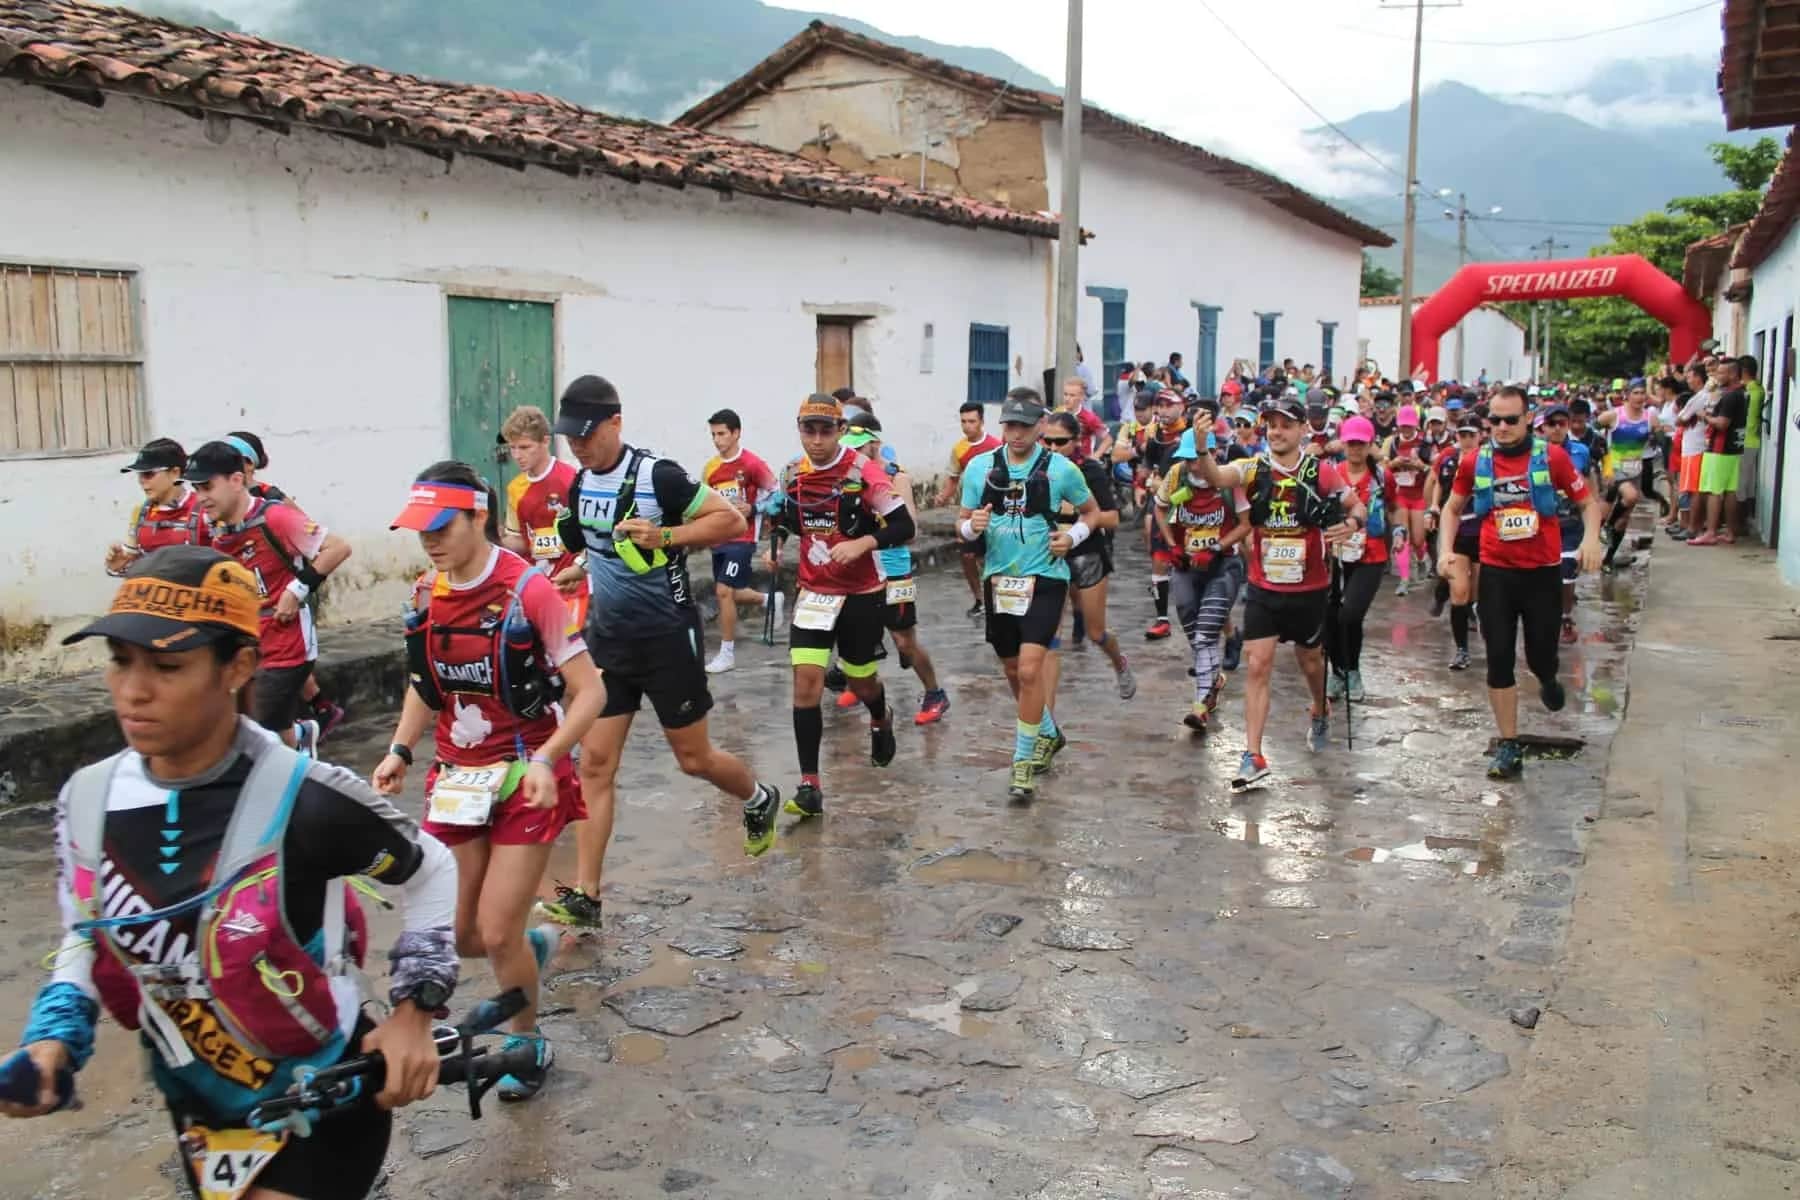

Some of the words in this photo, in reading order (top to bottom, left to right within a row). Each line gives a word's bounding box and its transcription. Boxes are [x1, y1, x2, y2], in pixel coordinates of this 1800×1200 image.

[1482, 266, 1617, 294] SPECIALIZED
[1504, 516, 1531, 528] 401
[536, 536, 558, 547] 431
[1272, 547, 1297, 559] 308
[725, 560, 739, 577] 10
[1003, 578, 1025, 590] 273
